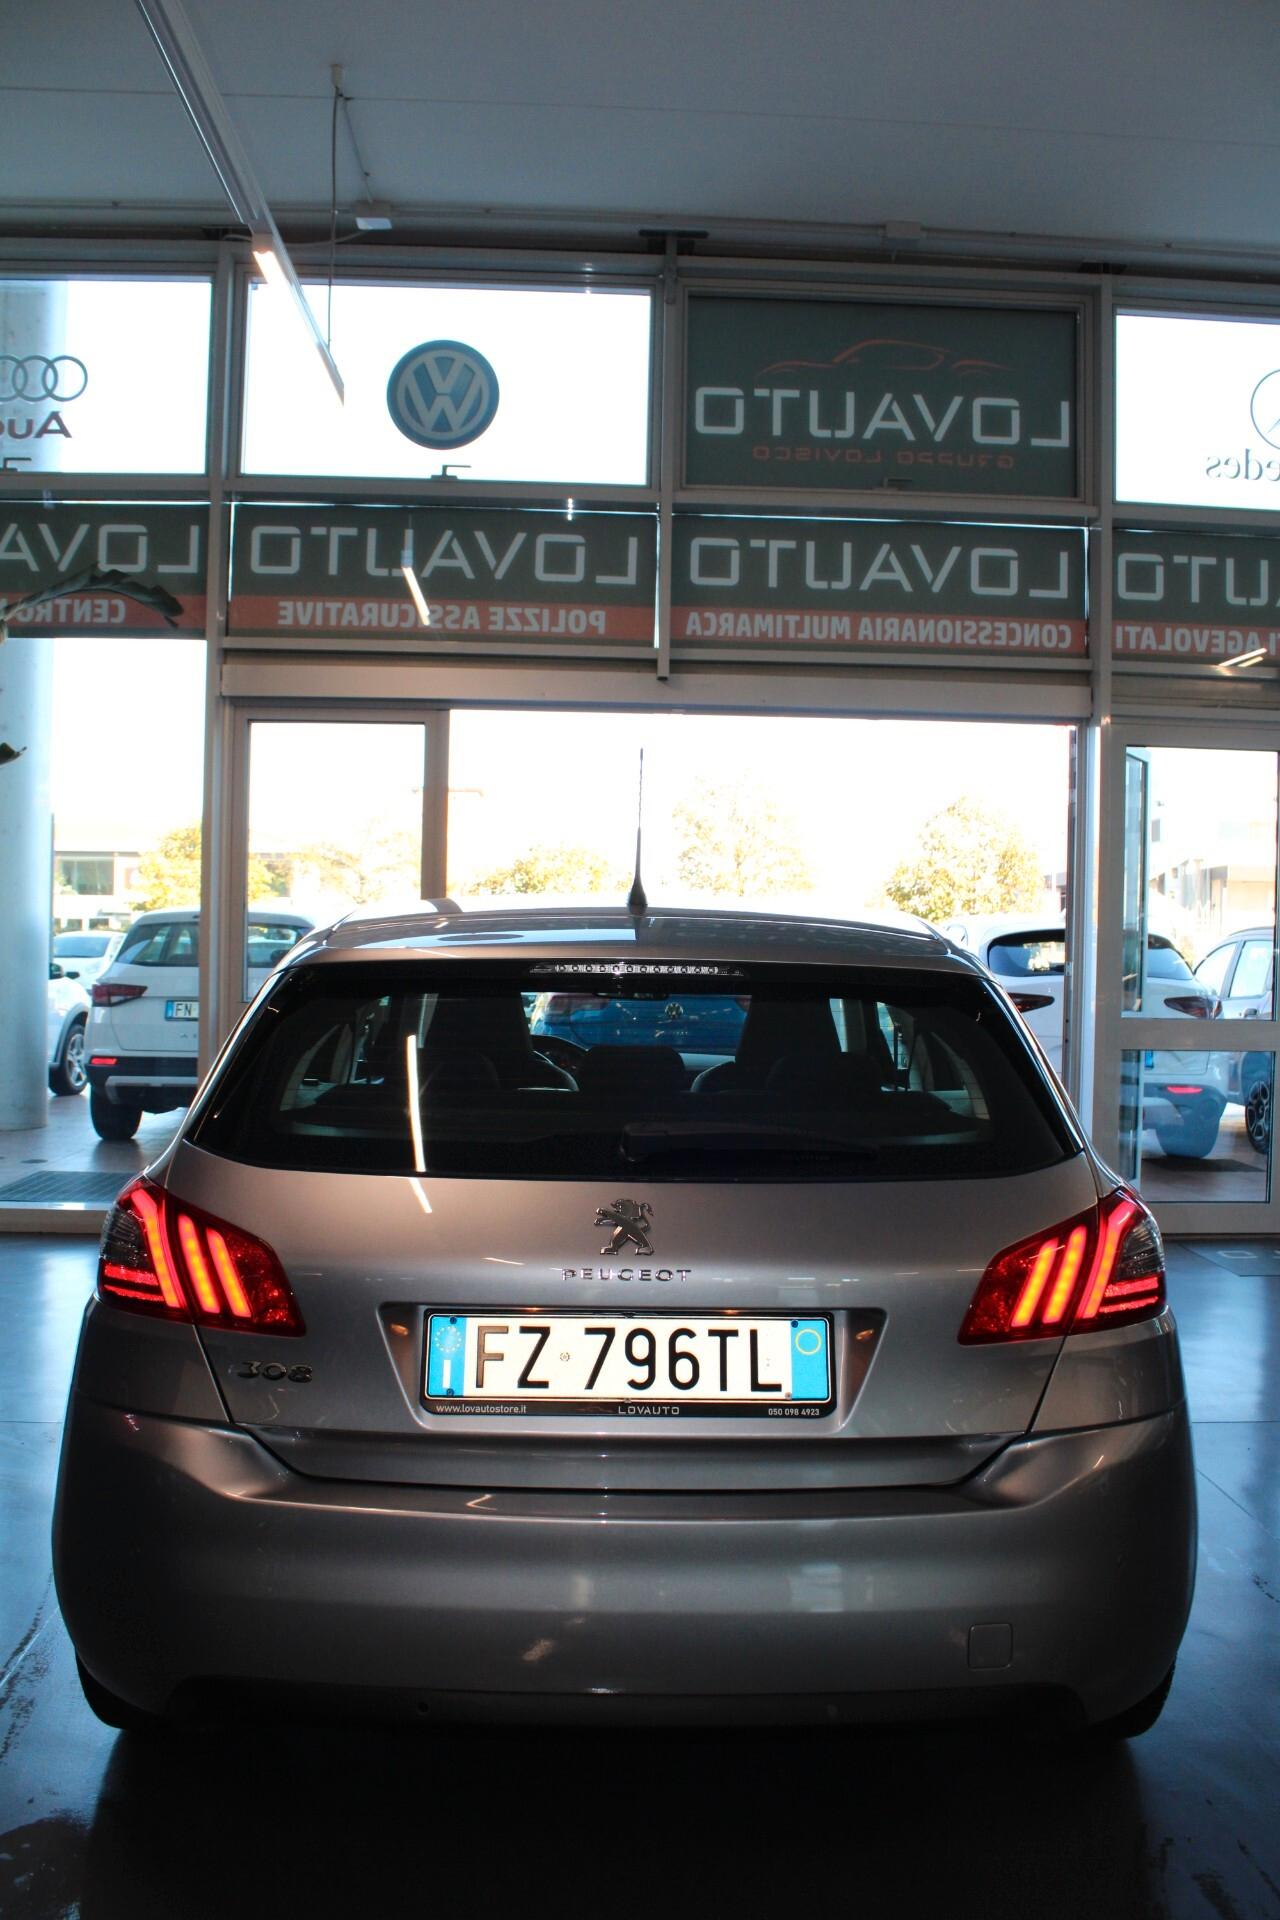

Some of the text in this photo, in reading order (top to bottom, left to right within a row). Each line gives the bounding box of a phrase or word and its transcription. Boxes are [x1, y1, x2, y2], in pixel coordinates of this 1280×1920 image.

[561, 1267, 692, 1281] PEUGEOT
[475, 1325, 783, 1391] FZ 796TL
[236, 1360, 313, 1383] 308
[435, 1404, 527, 1414] www.lovautostore.it
[617, 1405, 680, 1415] LOVAUTO
[768, 1407, 820, 1416] 050 098 4923
